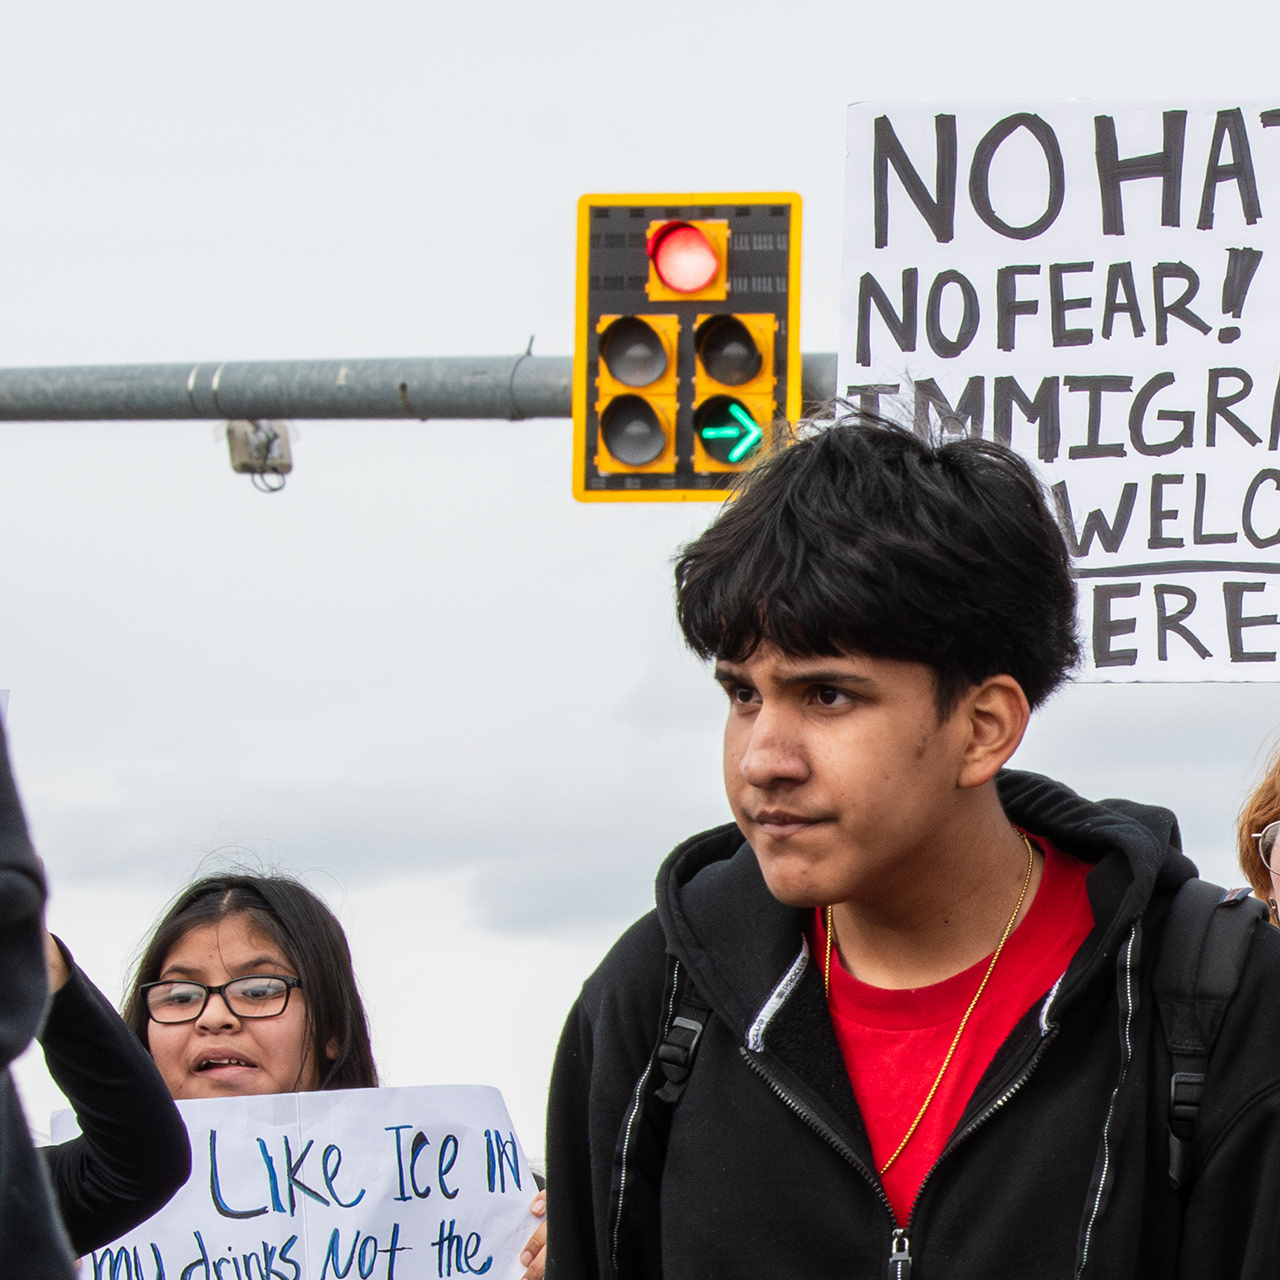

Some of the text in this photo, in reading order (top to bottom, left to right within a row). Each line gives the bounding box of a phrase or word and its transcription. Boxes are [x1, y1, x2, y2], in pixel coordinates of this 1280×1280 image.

[873, 112, 1065, 249] NO
[856, 247, 1264, 367] NO FEAR!
